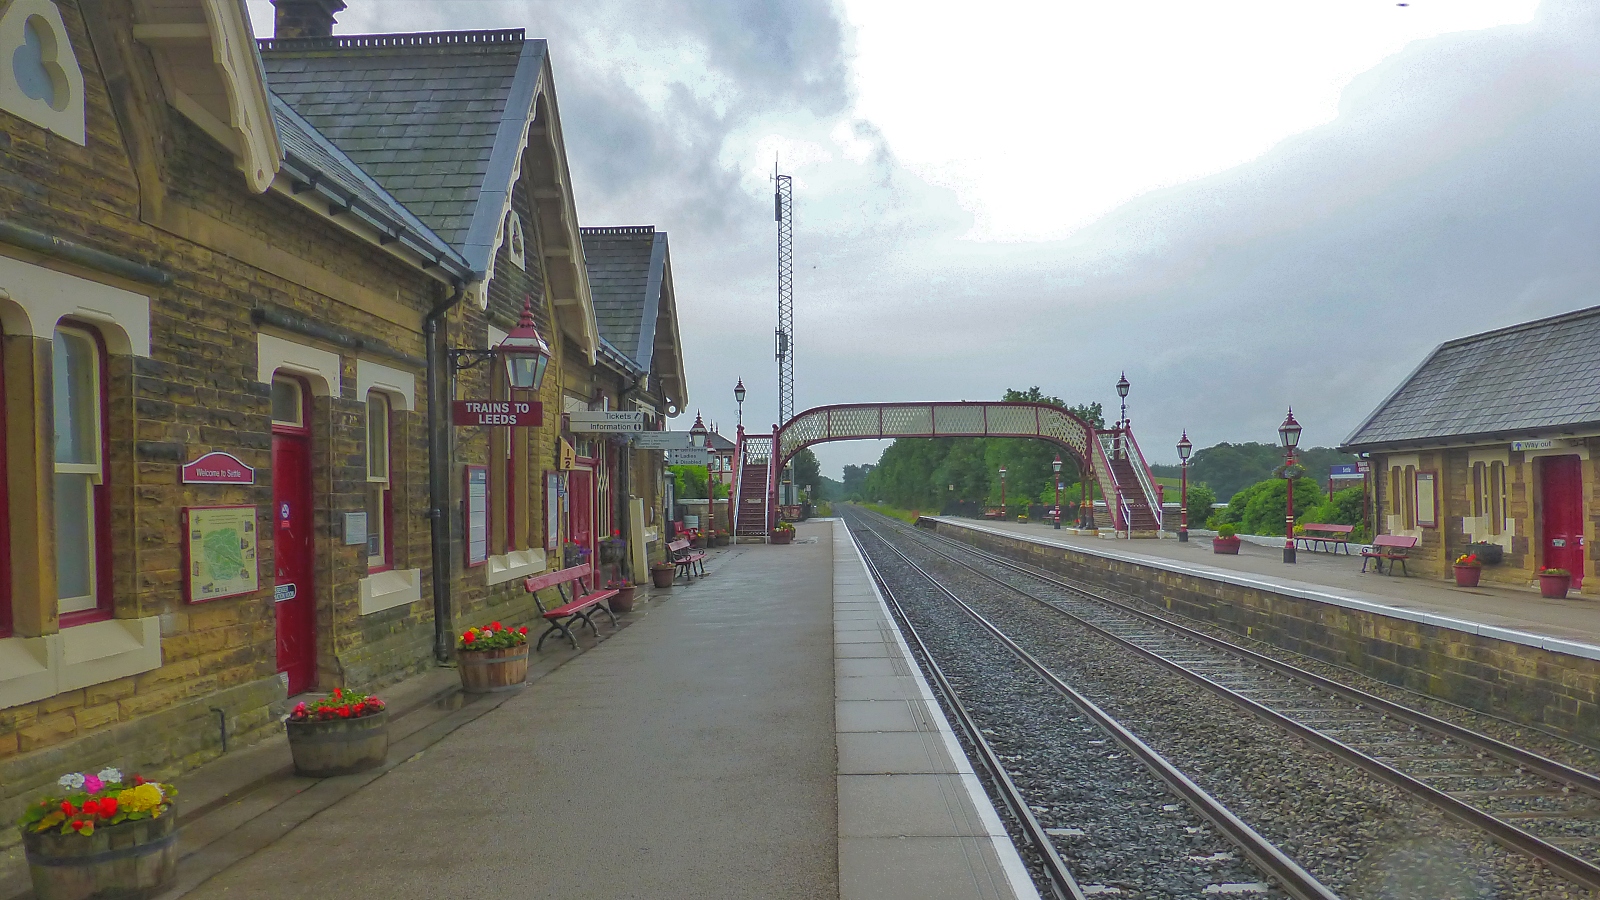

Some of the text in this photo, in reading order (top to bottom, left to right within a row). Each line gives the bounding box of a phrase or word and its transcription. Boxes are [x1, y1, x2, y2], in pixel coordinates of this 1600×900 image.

[465, 402, 530, 413] TRAINS TO
[478, 414, 517, 425] LEEDS
[590, 423, 631, 431] Information
[196, 468, 220, 477] Welcome
[226, 469, 241, 478] Settle
